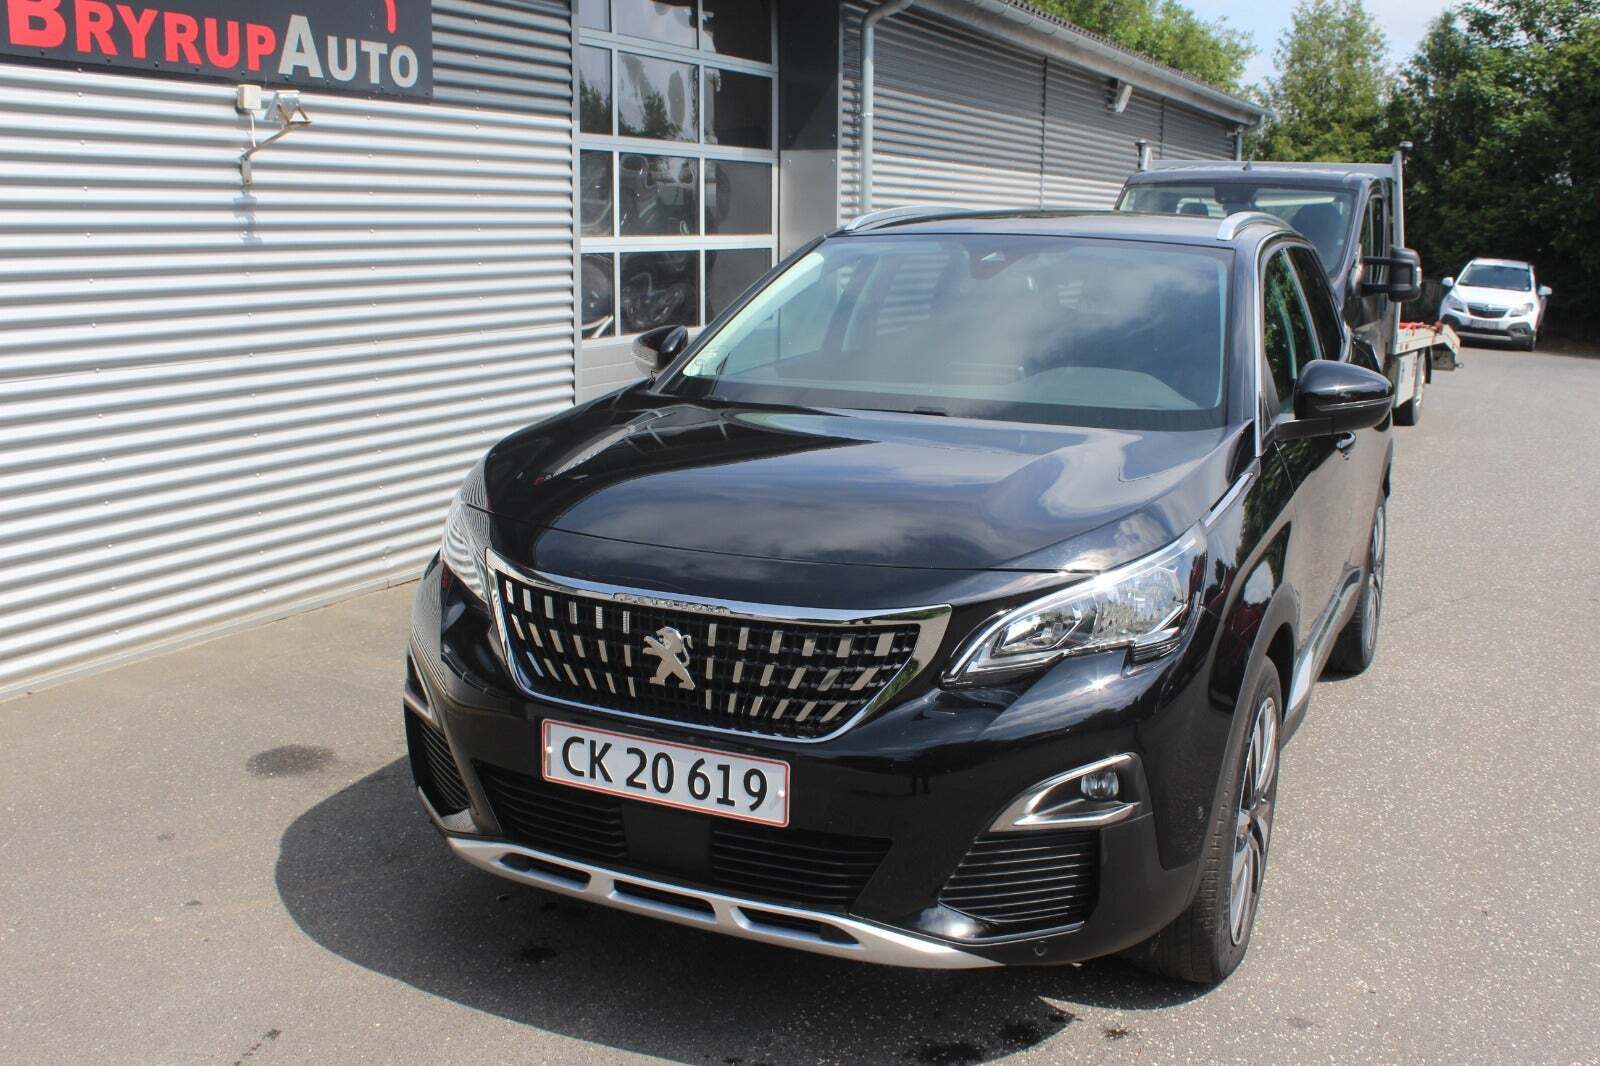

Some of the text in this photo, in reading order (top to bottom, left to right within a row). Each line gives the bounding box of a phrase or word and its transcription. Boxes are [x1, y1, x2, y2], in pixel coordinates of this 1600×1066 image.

[562, 736, 768, 811] CK 20 619
